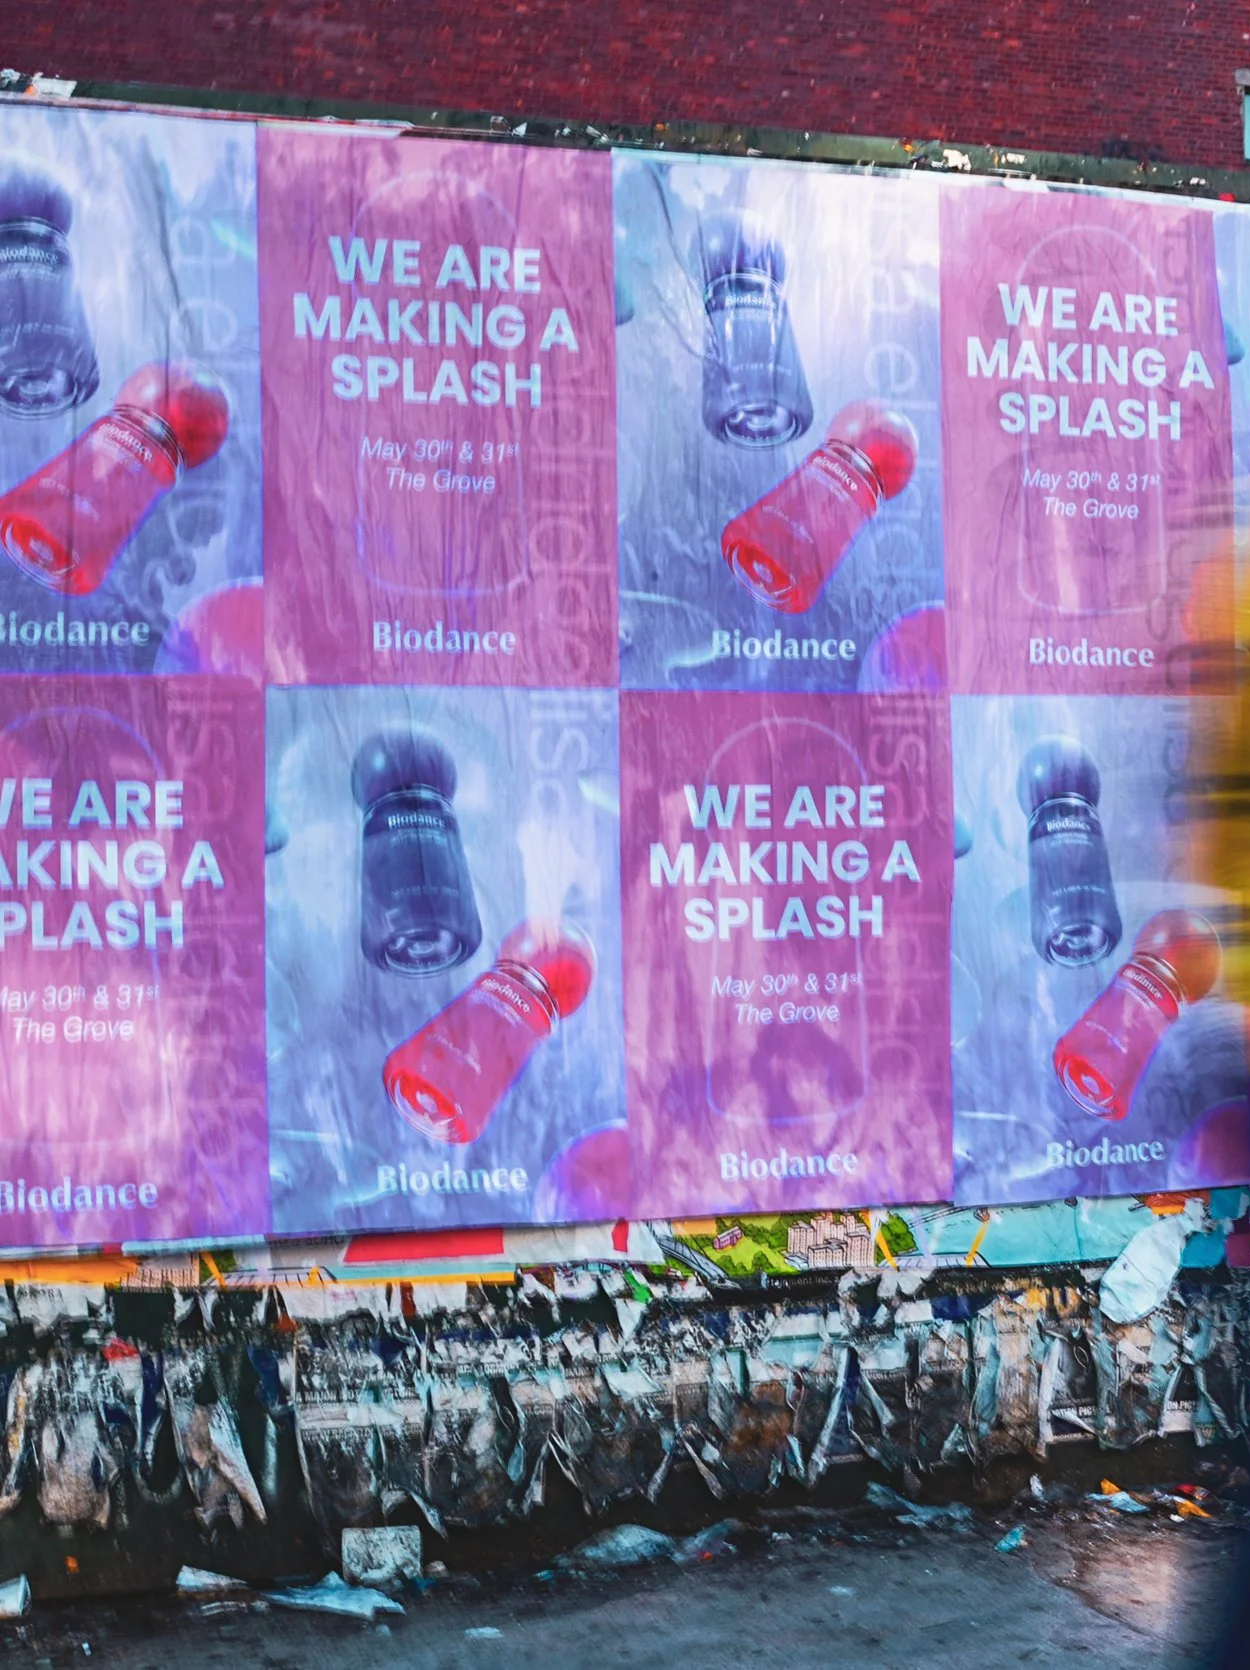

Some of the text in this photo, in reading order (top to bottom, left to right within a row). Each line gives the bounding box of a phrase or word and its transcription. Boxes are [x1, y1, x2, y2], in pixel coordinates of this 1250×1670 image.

[328, 236, 542, 294] WE ARE
[293, 293, 579, 353] MAKING A
[998, 283, 1178, 338] WE ARE
[967, 337, 1214, 389] MAKING A
[331, 354, 542, 408] SPLASH
[998, 392, 1180, 440] SPLASH
[360, 436, 406, 462] May
[459, 441, 474, 463] &
[386, 467, 497, 494] The Grove
[1022, 467, 1061, 492] May
[1107, 471, 1120, 491] &
[1043, 497, 1139, 520] The Grove
[0, 611, 150, 647] iodance
[372, 621, 516, 655] Biodance
[711, 631, 856, 661] Biodance
[1029, 638, 1154, 668] Biodance
[0, 778, 184, 830] E ARE
[684, 784, 885, 829] WE ARE
[181, 840, 225, 888] A
[649, 840, 920, 888] MAKING A
[683, 896, 884, 941] SPLASH
[92, 984, 109, 1011] &
[711, 973, 754, 999] May
[804, 973, 819, 995] &
[12, 1015, 135, 1044] The Grove
[735, 1001, 839, 1025] The Grove
[719, 1151, 859, 1182] Biodance
[1045, 1137, 1165, 1169] Biodance
[376, 1164, 528, 1196] Biodance
